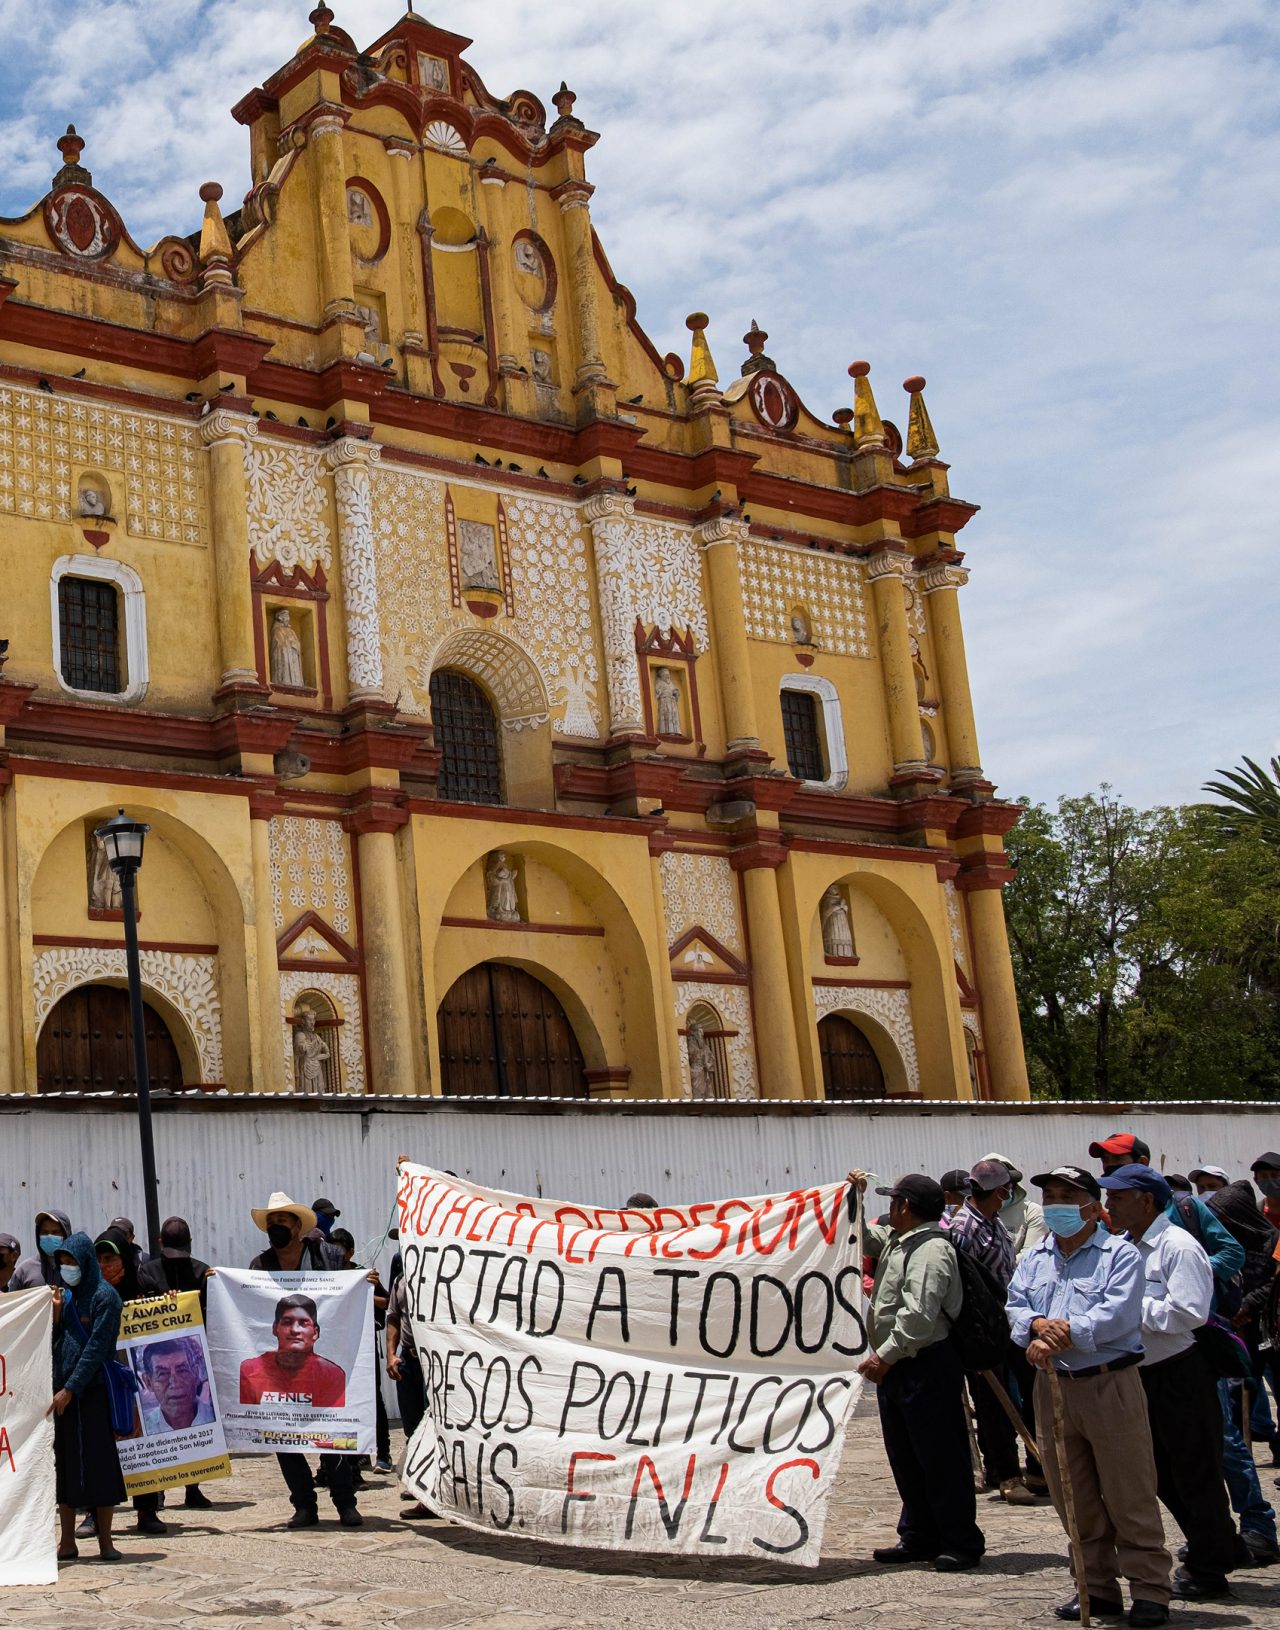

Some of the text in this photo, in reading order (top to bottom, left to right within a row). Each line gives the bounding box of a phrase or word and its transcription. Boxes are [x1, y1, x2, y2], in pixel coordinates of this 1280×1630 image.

[122, 1302, 178, 1322] Y ÁLVARO
[586, 1266, 631, 1343] A
[654, 1265, 869, 1358] TODOS
[123, 1313, 193, 1335] REYES CRUZ
[278, 1392, 312, 1404] FNLS
[558, 1360, 851, 1455] POLITICOS
[136, 1443, 144, 1451] 27
[146, 1441, 155, 1449] de
[156, 1434, 188, 1447] diciembre
[189, 1432, 198, 1441] de
[198, 1428, 214, 1439] 2017
[138, 1447, 169, 1460] zapoteca
[170, 1445, 178, 1453] de
[179, 1443, 192, 1452] San
[193, 1437, 214, 1449] Miguel
[264, 1436, 309, 1446] Estado
[159, 1474, 177, 1484] vivos
[178, 1471, 189, 1480] los
[562, 1450, 822, 1555] FNLS
